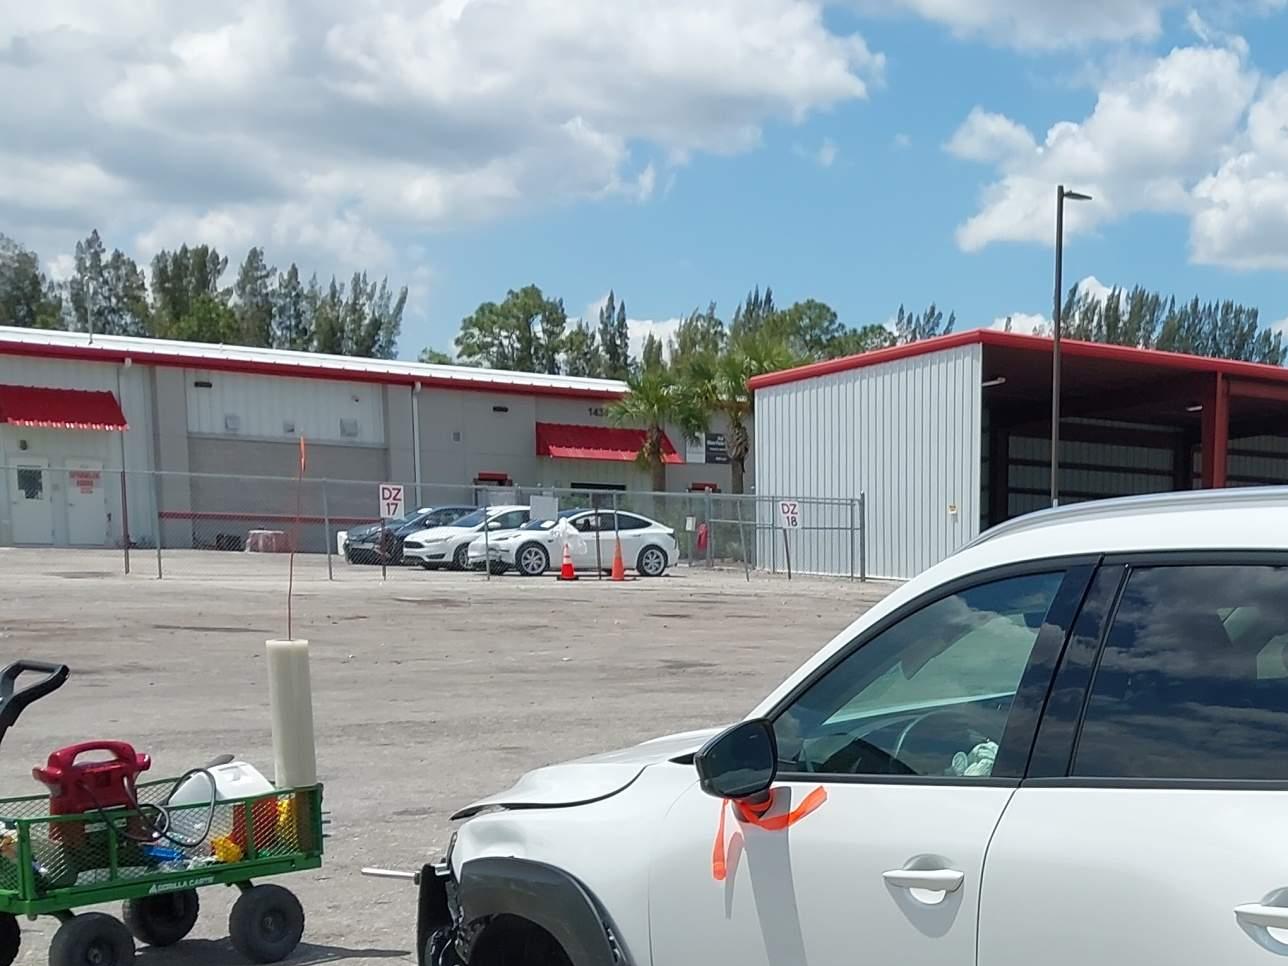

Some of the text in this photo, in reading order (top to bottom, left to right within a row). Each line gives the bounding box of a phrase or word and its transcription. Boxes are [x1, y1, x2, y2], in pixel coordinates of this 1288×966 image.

[382, 487, 402, 501] DZ
[386, 502, 398, 516] 17
[781, 503, 798, 515] DZ
[786, 516, 798, 527] 18
